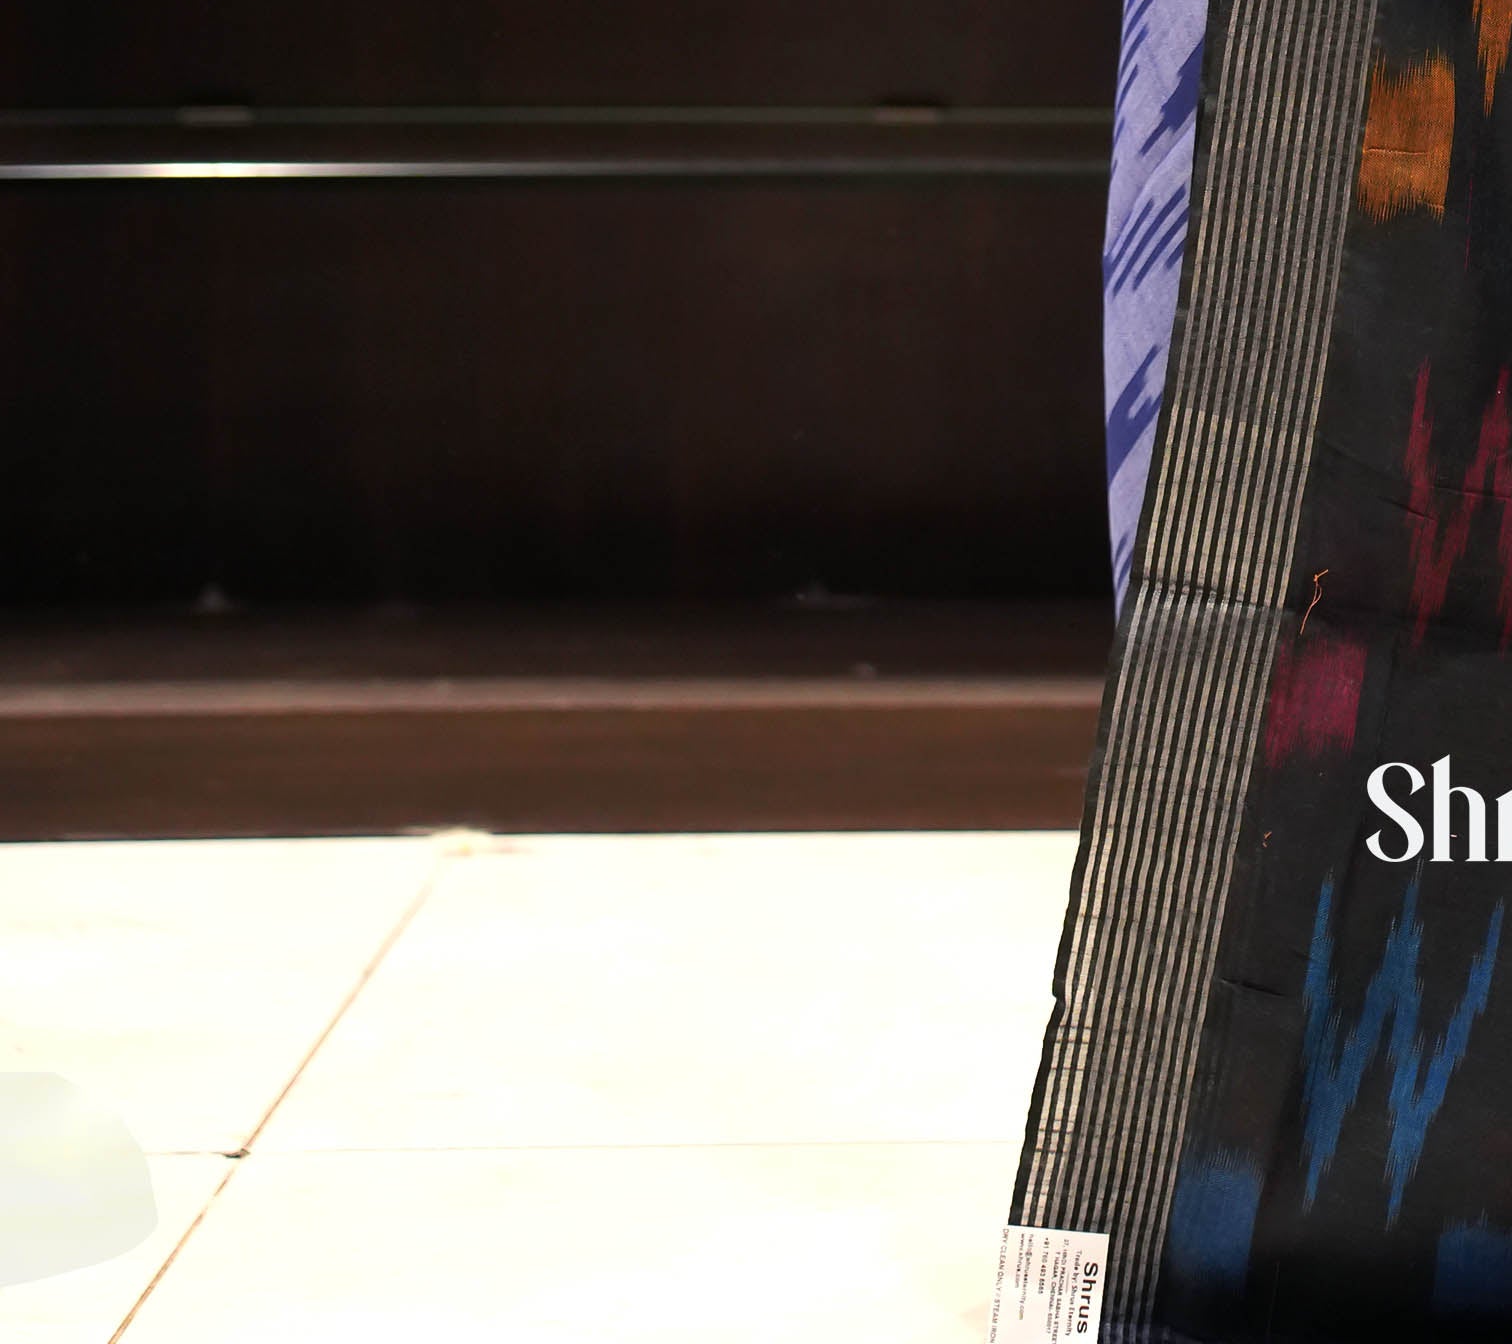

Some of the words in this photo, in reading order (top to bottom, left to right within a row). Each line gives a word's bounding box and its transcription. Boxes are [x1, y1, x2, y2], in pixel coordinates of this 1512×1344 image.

[999, 1245, 1008, 1270] CLEAN
[1075, 1250, 1083, 1271] Trade
[1058, 1267, 1066, 1296] PRACHAR
[1071, 1272, 1079, 1284] by:
[1070, 1285, 1078, 1305] Shrus
[1077, 1262, 1099, 1333] Shrus
[992, 1298, 1001, 1324] STEAM
[1065, 1307, 1075, 1337] Eternity
